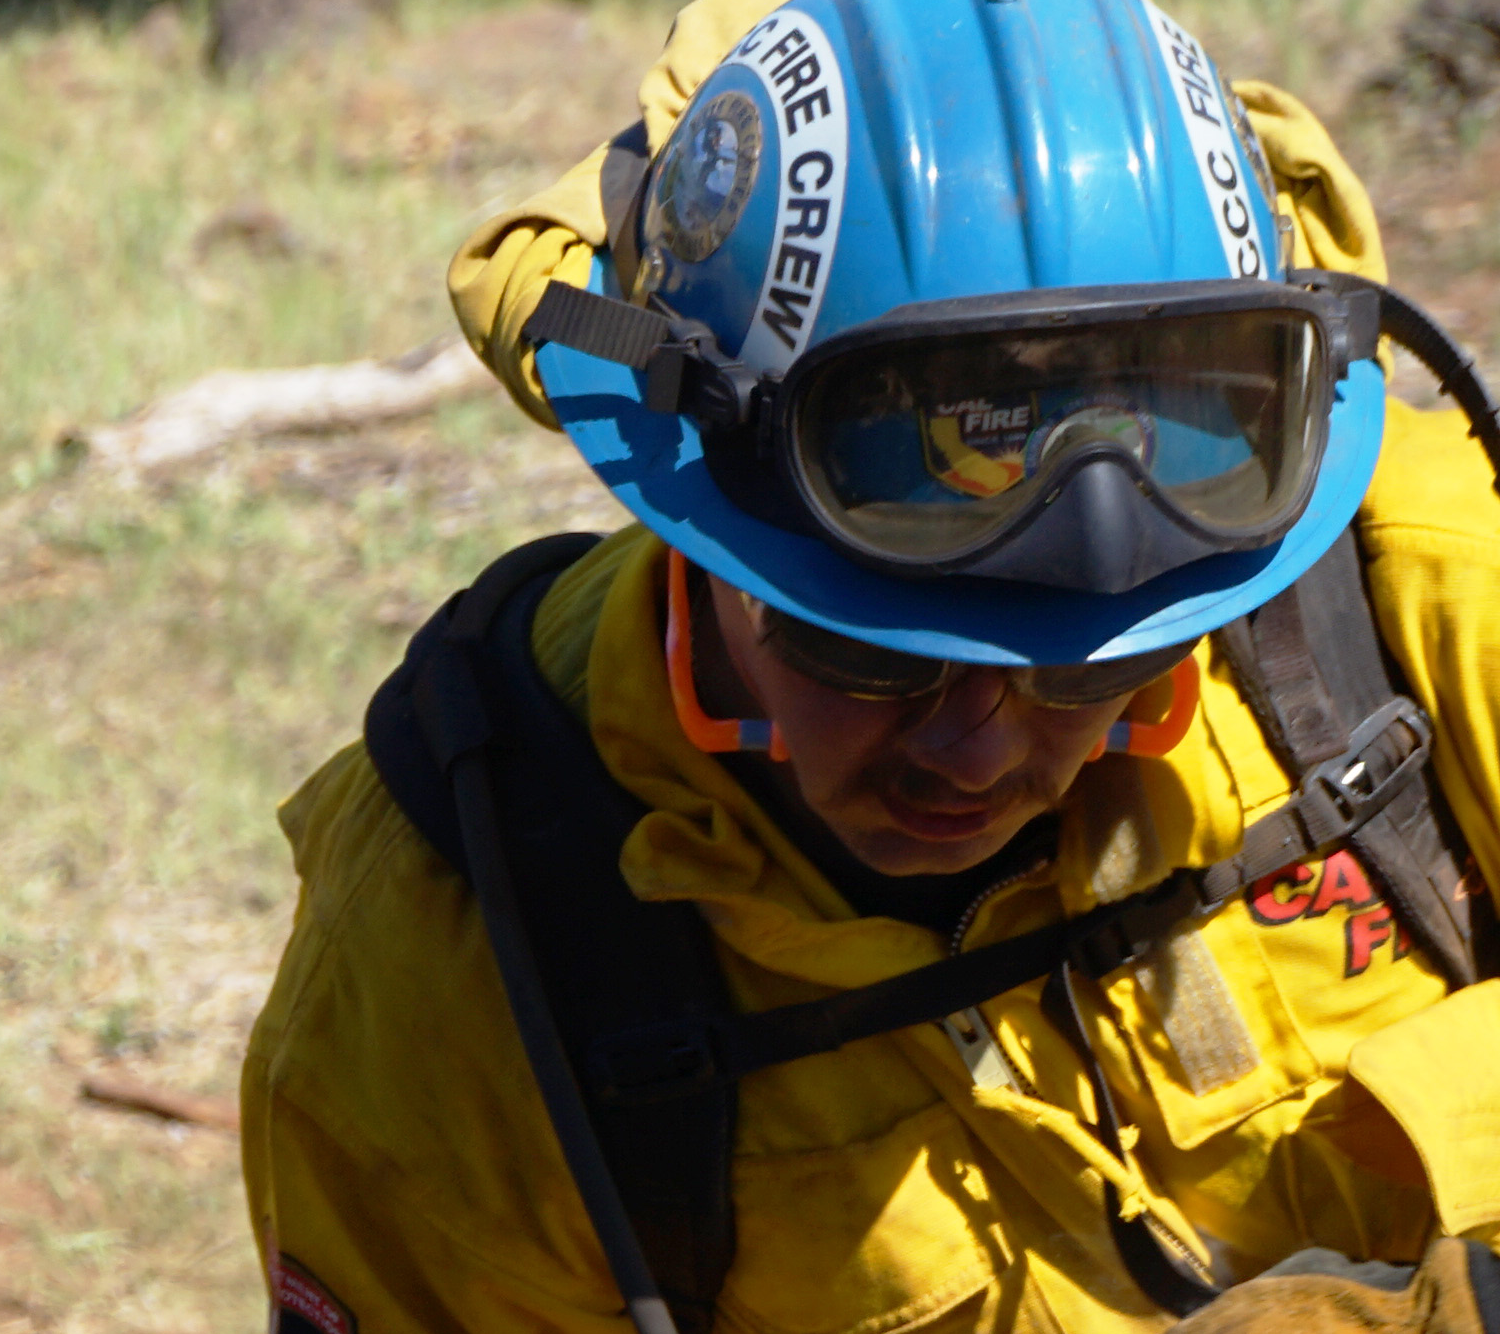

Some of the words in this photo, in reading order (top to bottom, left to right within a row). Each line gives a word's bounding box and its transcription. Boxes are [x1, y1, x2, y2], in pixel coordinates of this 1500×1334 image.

[758, 27, 832, 136] FIRE
[1160, 20, 1221, 128] FIRE
[761, 150, 833, 352] CREW
[1206, 149, 1260, 279] CCC
[965, 405, 1030, 434] FIRE
[1245, 849, 1380, 928] CA
